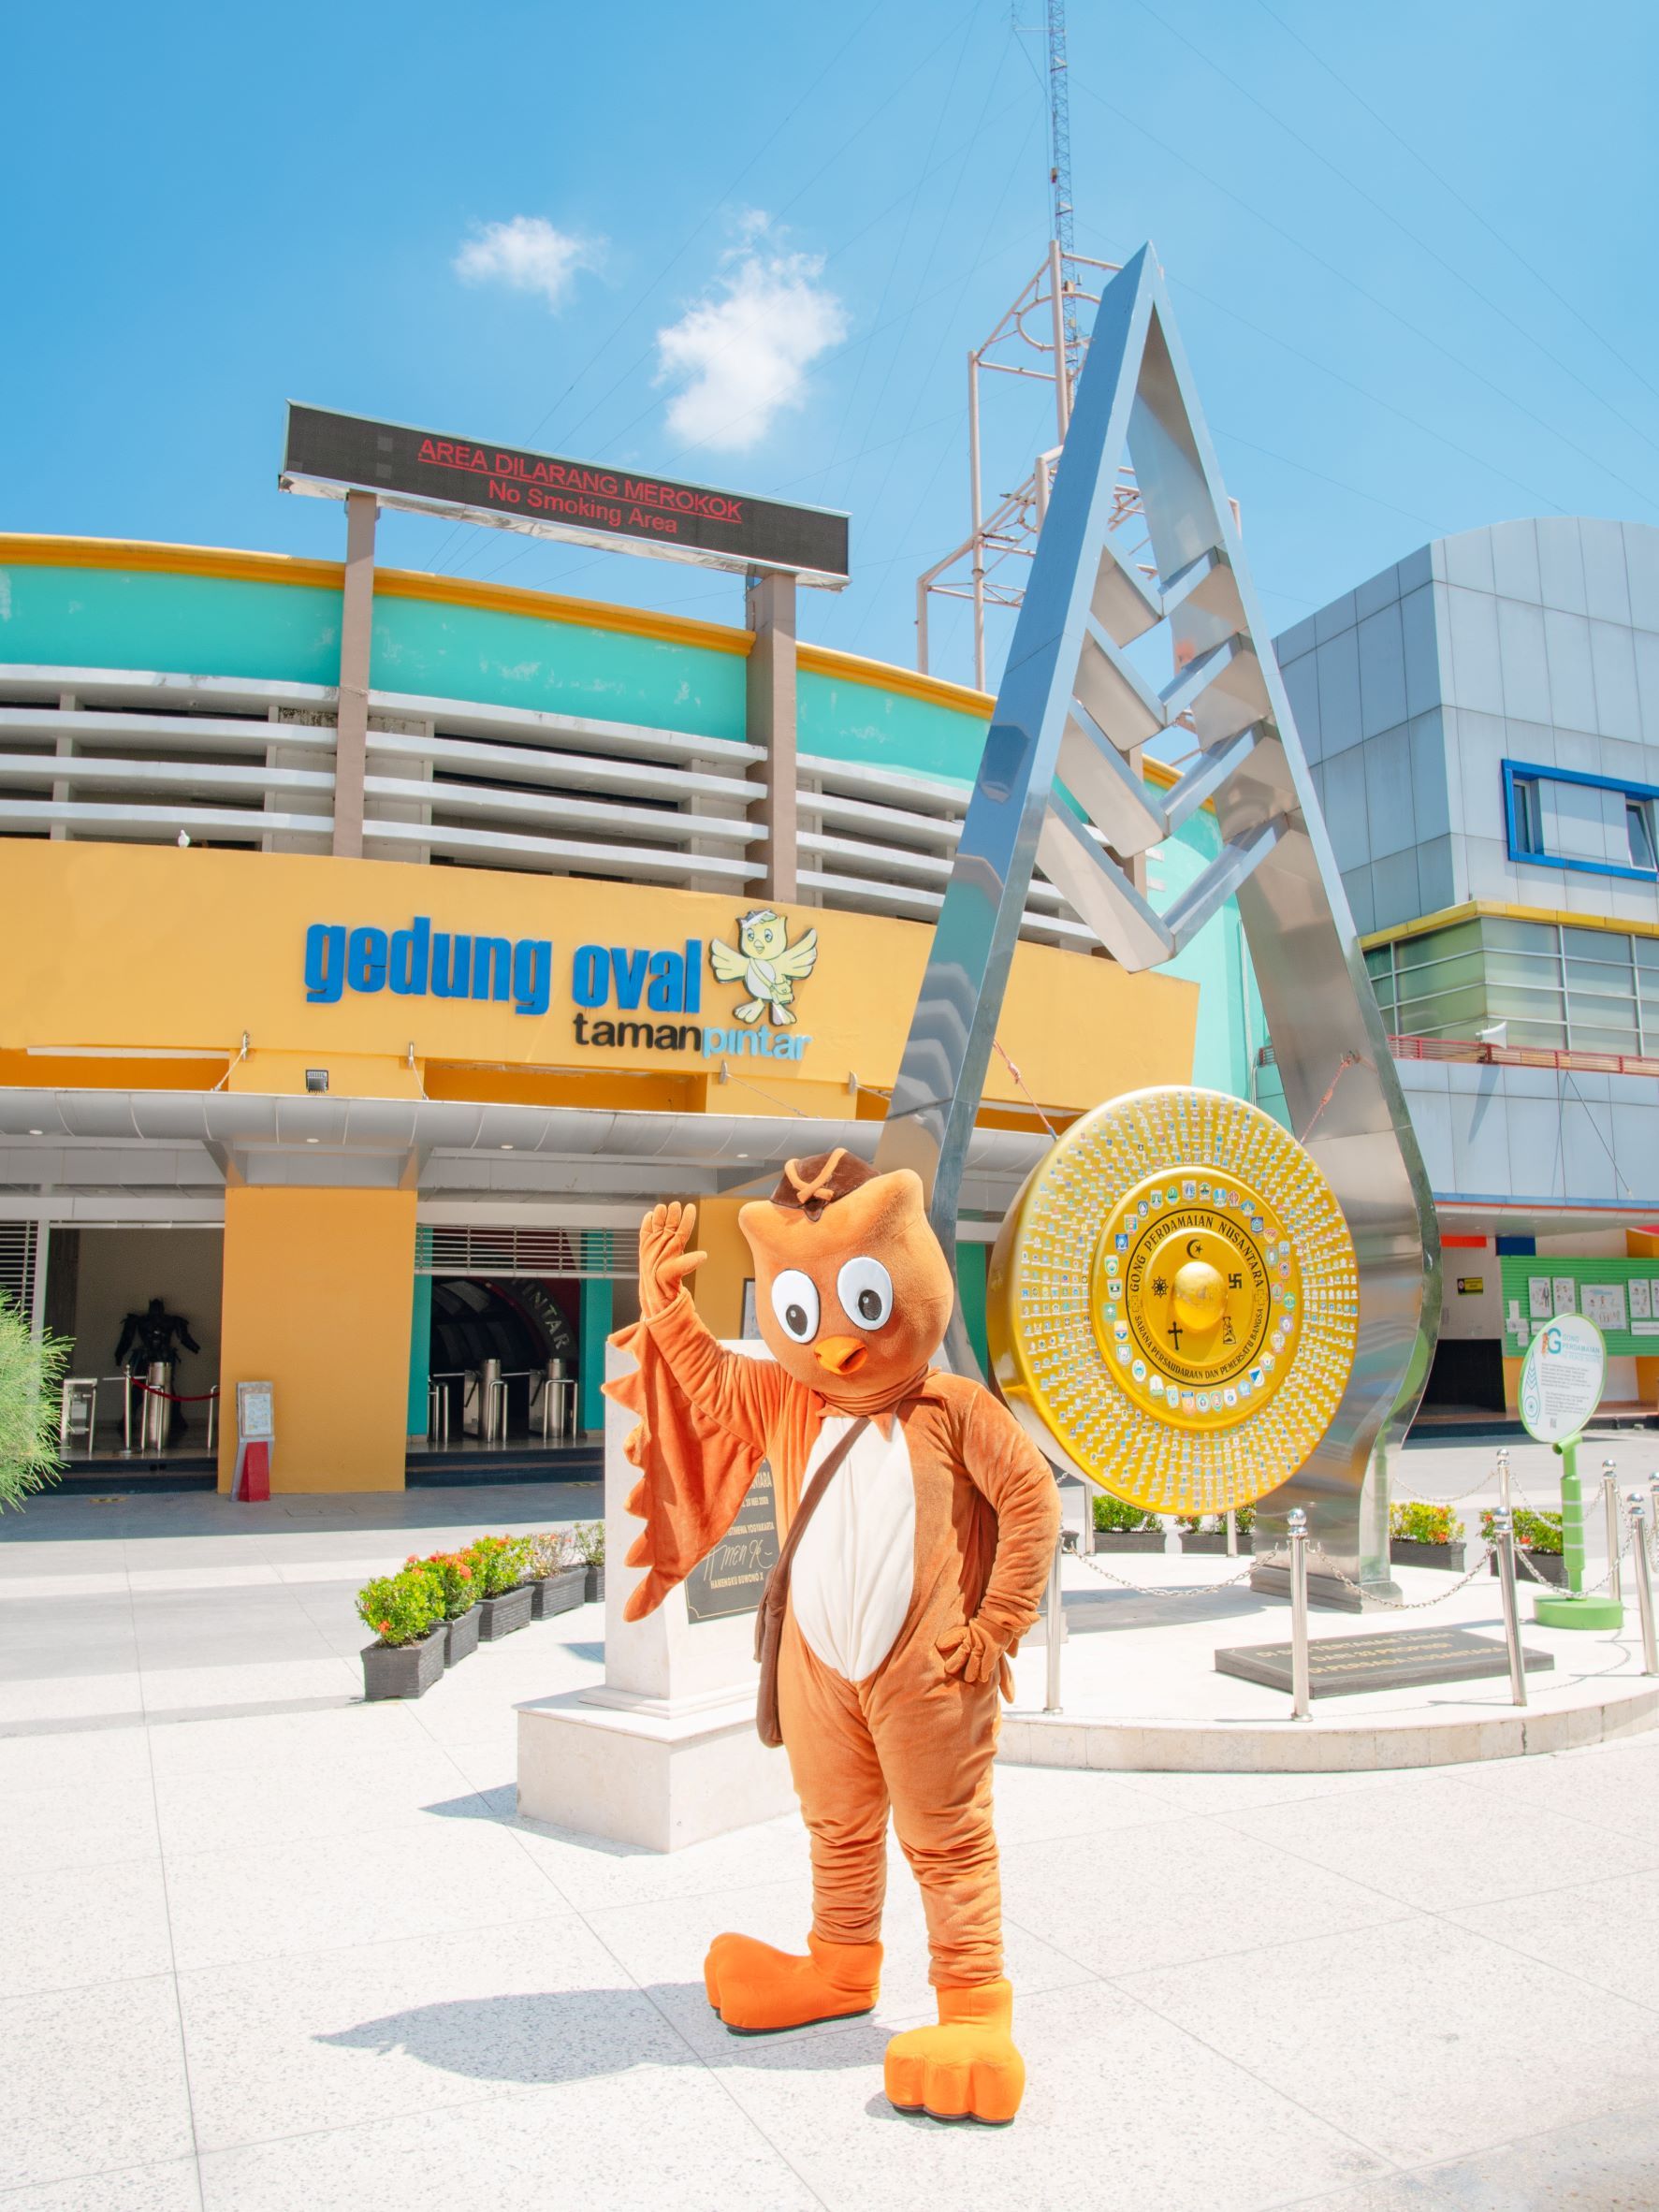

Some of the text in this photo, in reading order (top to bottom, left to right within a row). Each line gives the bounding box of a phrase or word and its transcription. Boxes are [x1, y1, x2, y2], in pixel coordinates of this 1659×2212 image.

[418, 439, 743, 520] AREA DILARANG MEROKOK
[488, 479, 678, 533] No Smoking Area
[304, 915, 702, 1015] gedung oval
[1130, 1215, 1264, 1292] GONG PERDAMAIAN NUSANTARA
[1134, 1309, 1264, 1379] SARANA PERSAUDARAAN DAN PEMERSATU BANGSA
